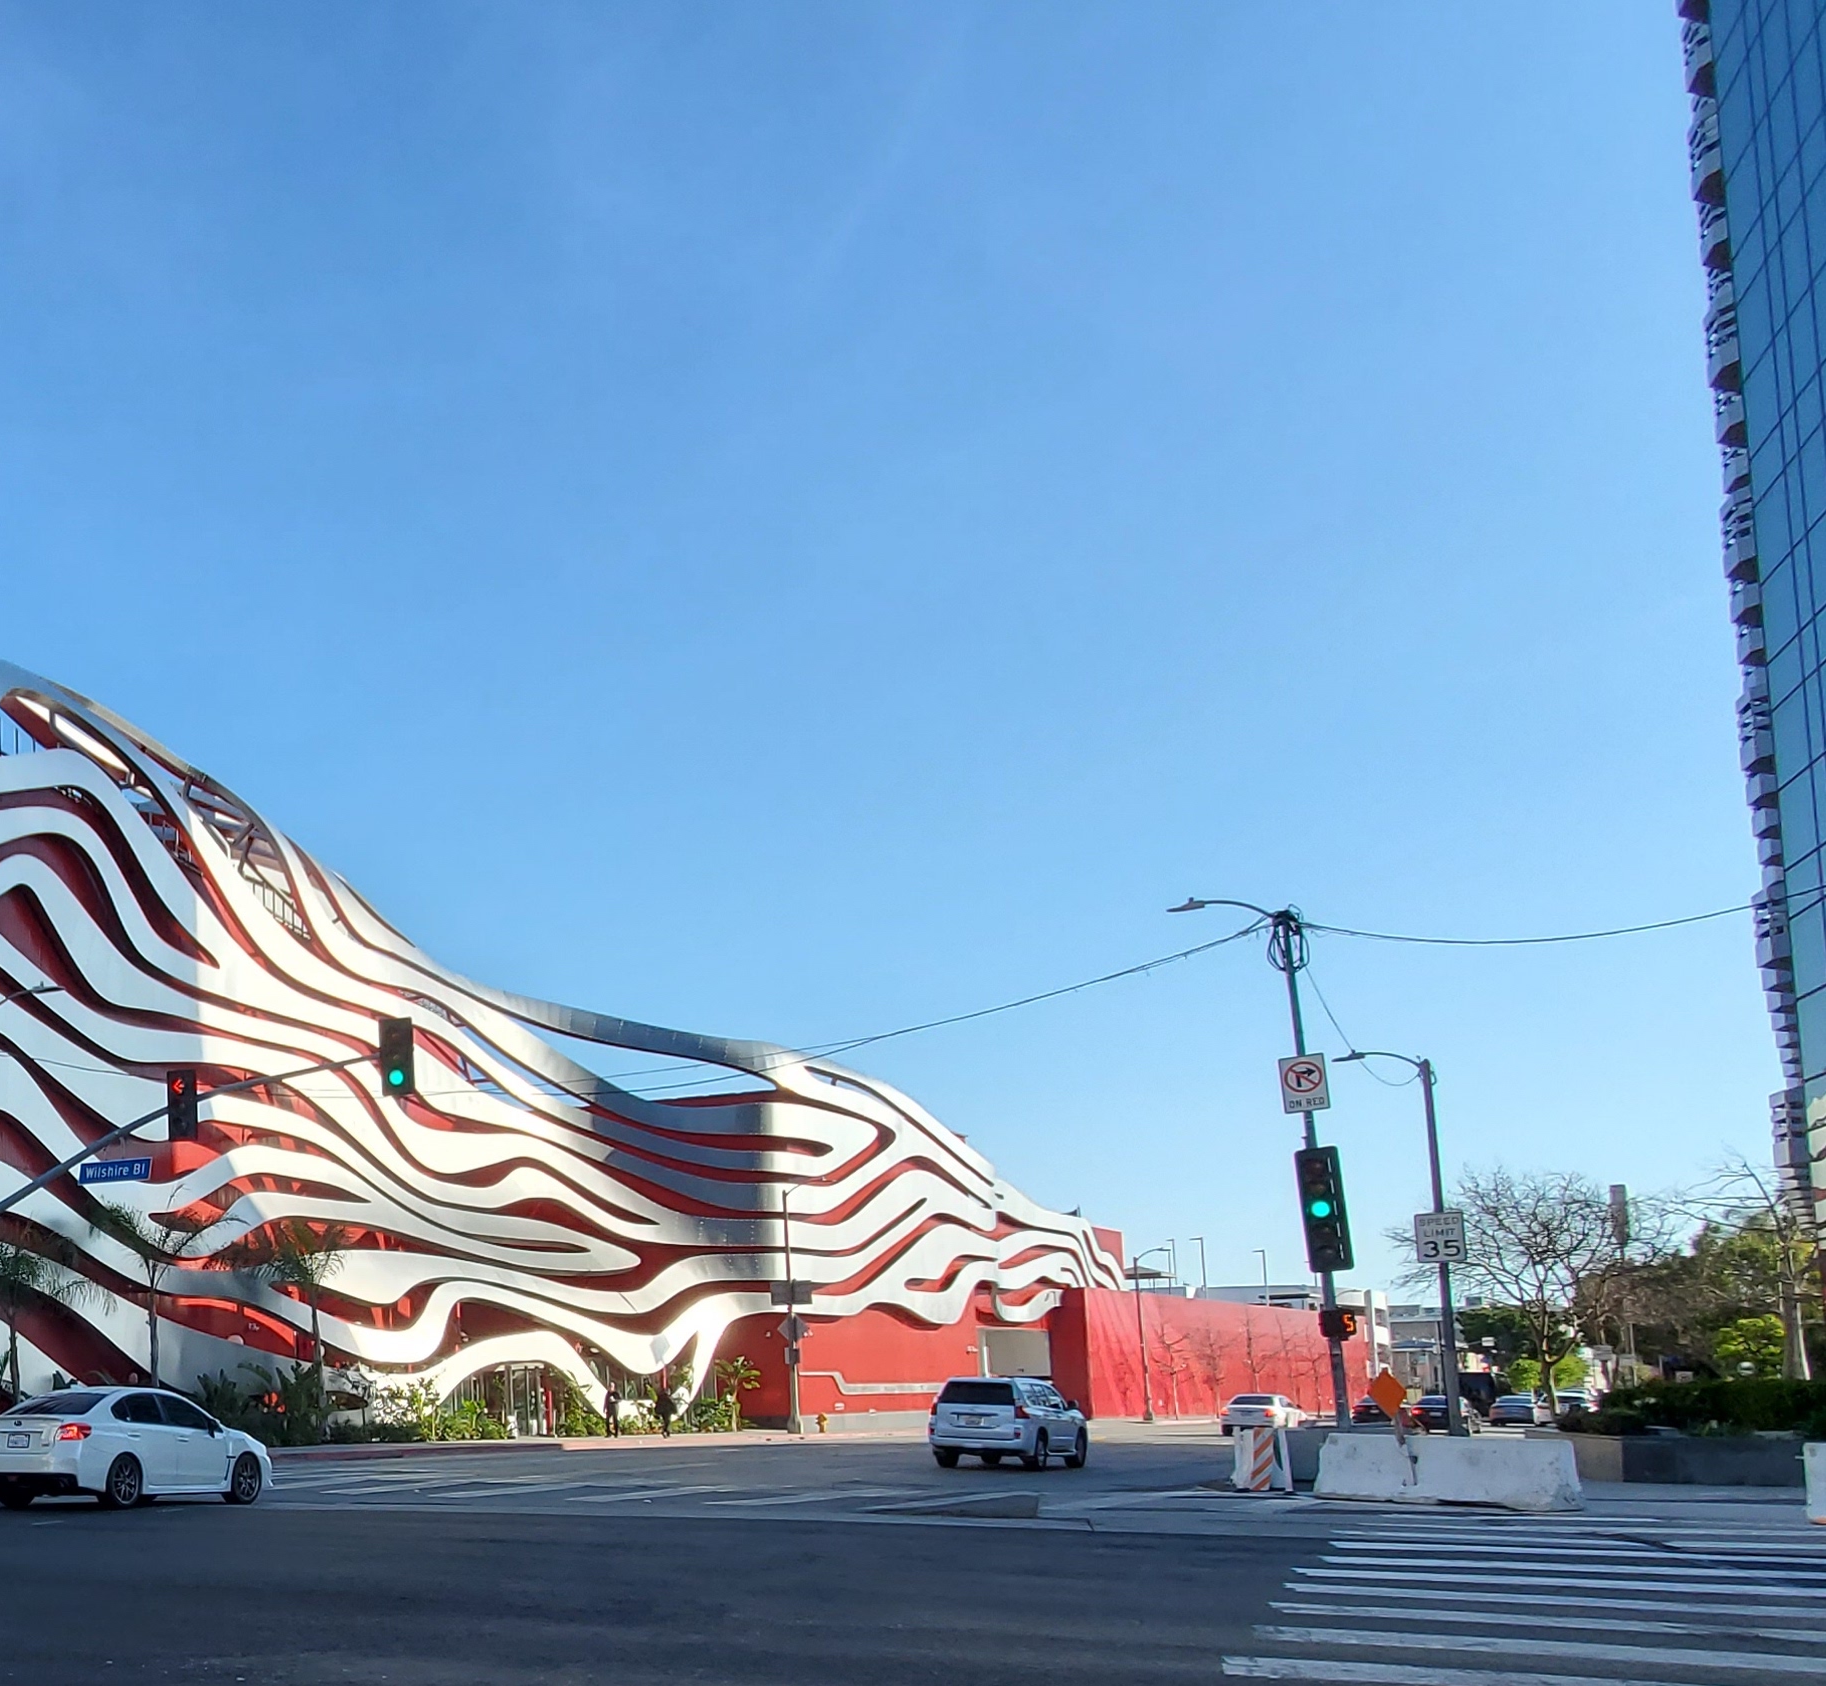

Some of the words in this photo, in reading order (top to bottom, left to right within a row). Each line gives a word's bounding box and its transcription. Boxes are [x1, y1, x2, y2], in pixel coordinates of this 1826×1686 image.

[1289, 1099, 1302, 1109] ON
[1306, 1096, 1325, 1107] RED
[85, 1164, 130, 1179] Wilshire
[133, 1163, 145, 1175] Bl
[1419, 1216, 1460, 1227] SPEED
[1424, 1228, 1456, 1238] LIMIT
[1423, 1239, 1461, 1258] 35
